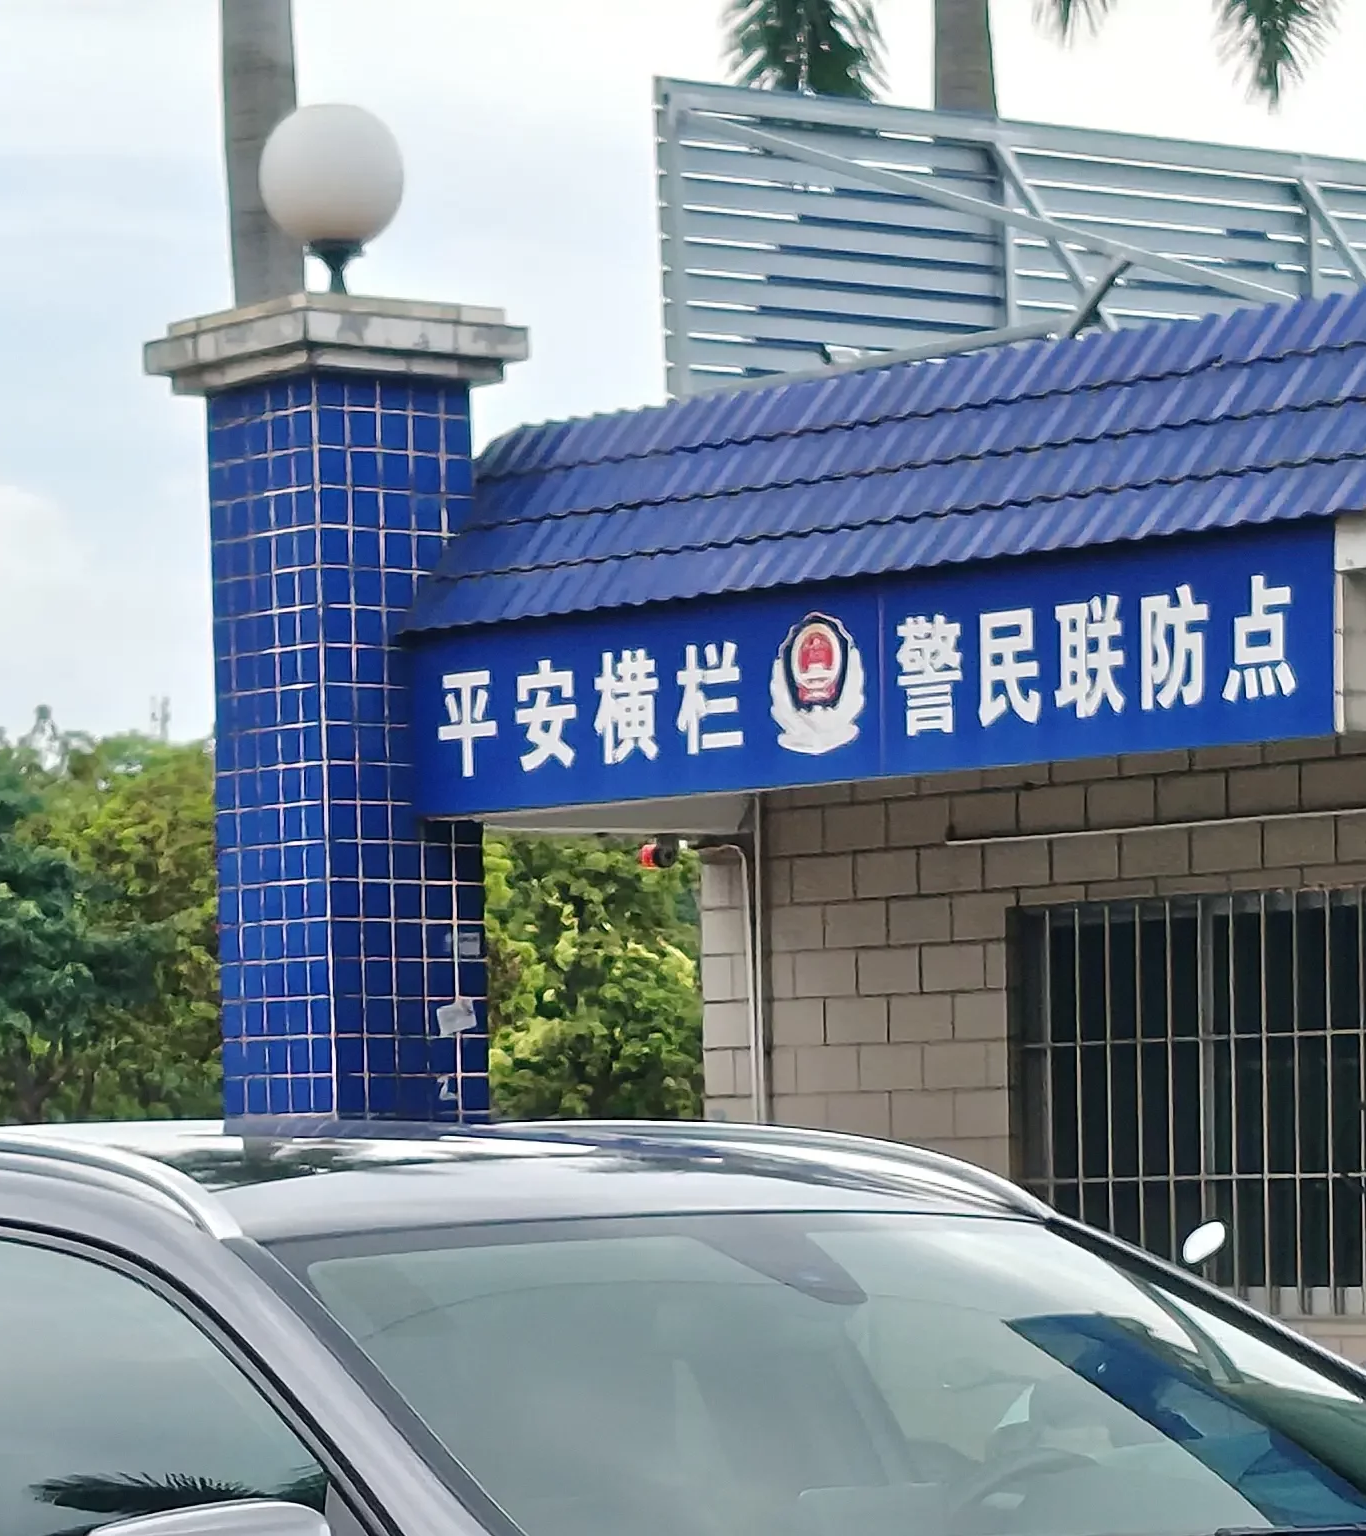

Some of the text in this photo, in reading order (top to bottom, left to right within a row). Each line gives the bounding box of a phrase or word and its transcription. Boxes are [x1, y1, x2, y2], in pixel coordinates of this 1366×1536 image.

[438, 574, 1298, 778] 平安横栏 警民联防点
